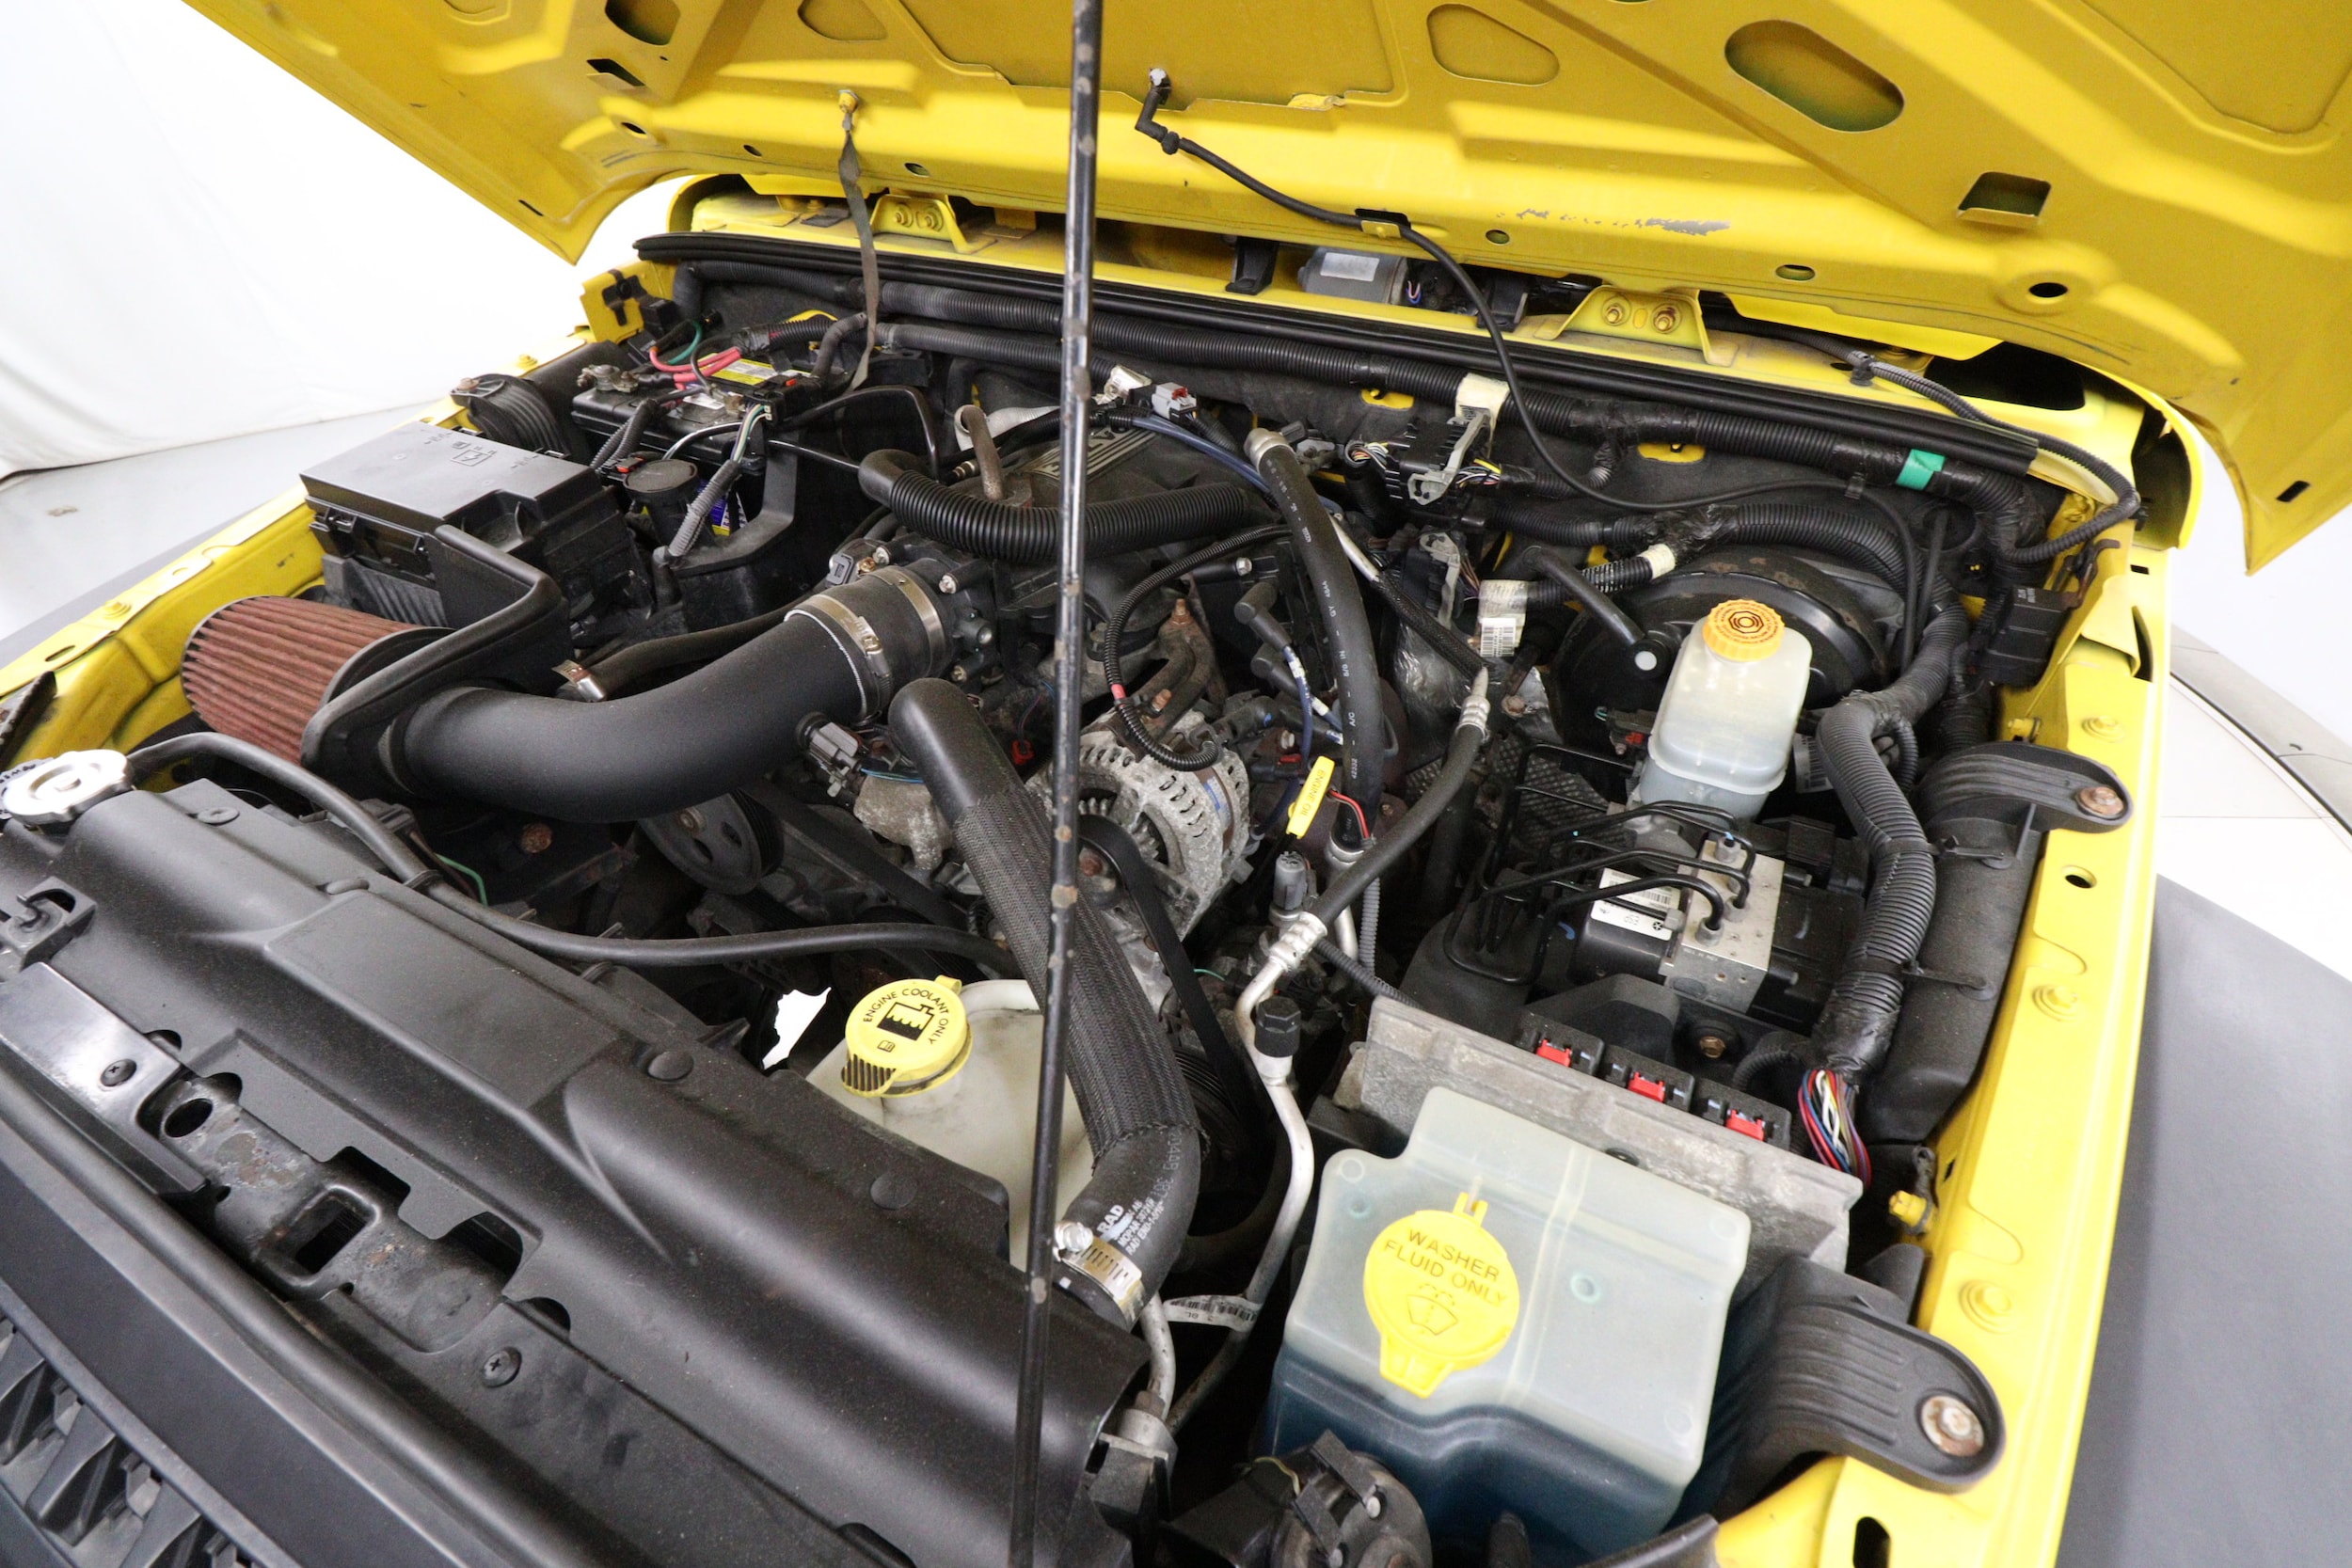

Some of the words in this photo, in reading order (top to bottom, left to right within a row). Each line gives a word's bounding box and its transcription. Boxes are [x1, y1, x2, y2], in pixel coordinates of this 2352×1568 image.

[1347, 711, 1356, 727] A/C
[1307, 768, 1327, 802] ENGINE
[1299, 803, 1311, 816] OIL
[863, 991, 898, 1022] ENGINE
[901, 988, 949, 1014] COOLANT
[929, 1018, 949, 1044] ONLY
[1096, 1204, 1124, 1234] RAD
[1117, 1220, 1141, 1247] MOPAR
[1125, 1238, 1141, 1256] RAD
[1408, 1229, 1501, 1282] WASHER
[1383, 1239, 1445, 1277] FLUID
[1451, 1272, 1508, 1307] ONLY
